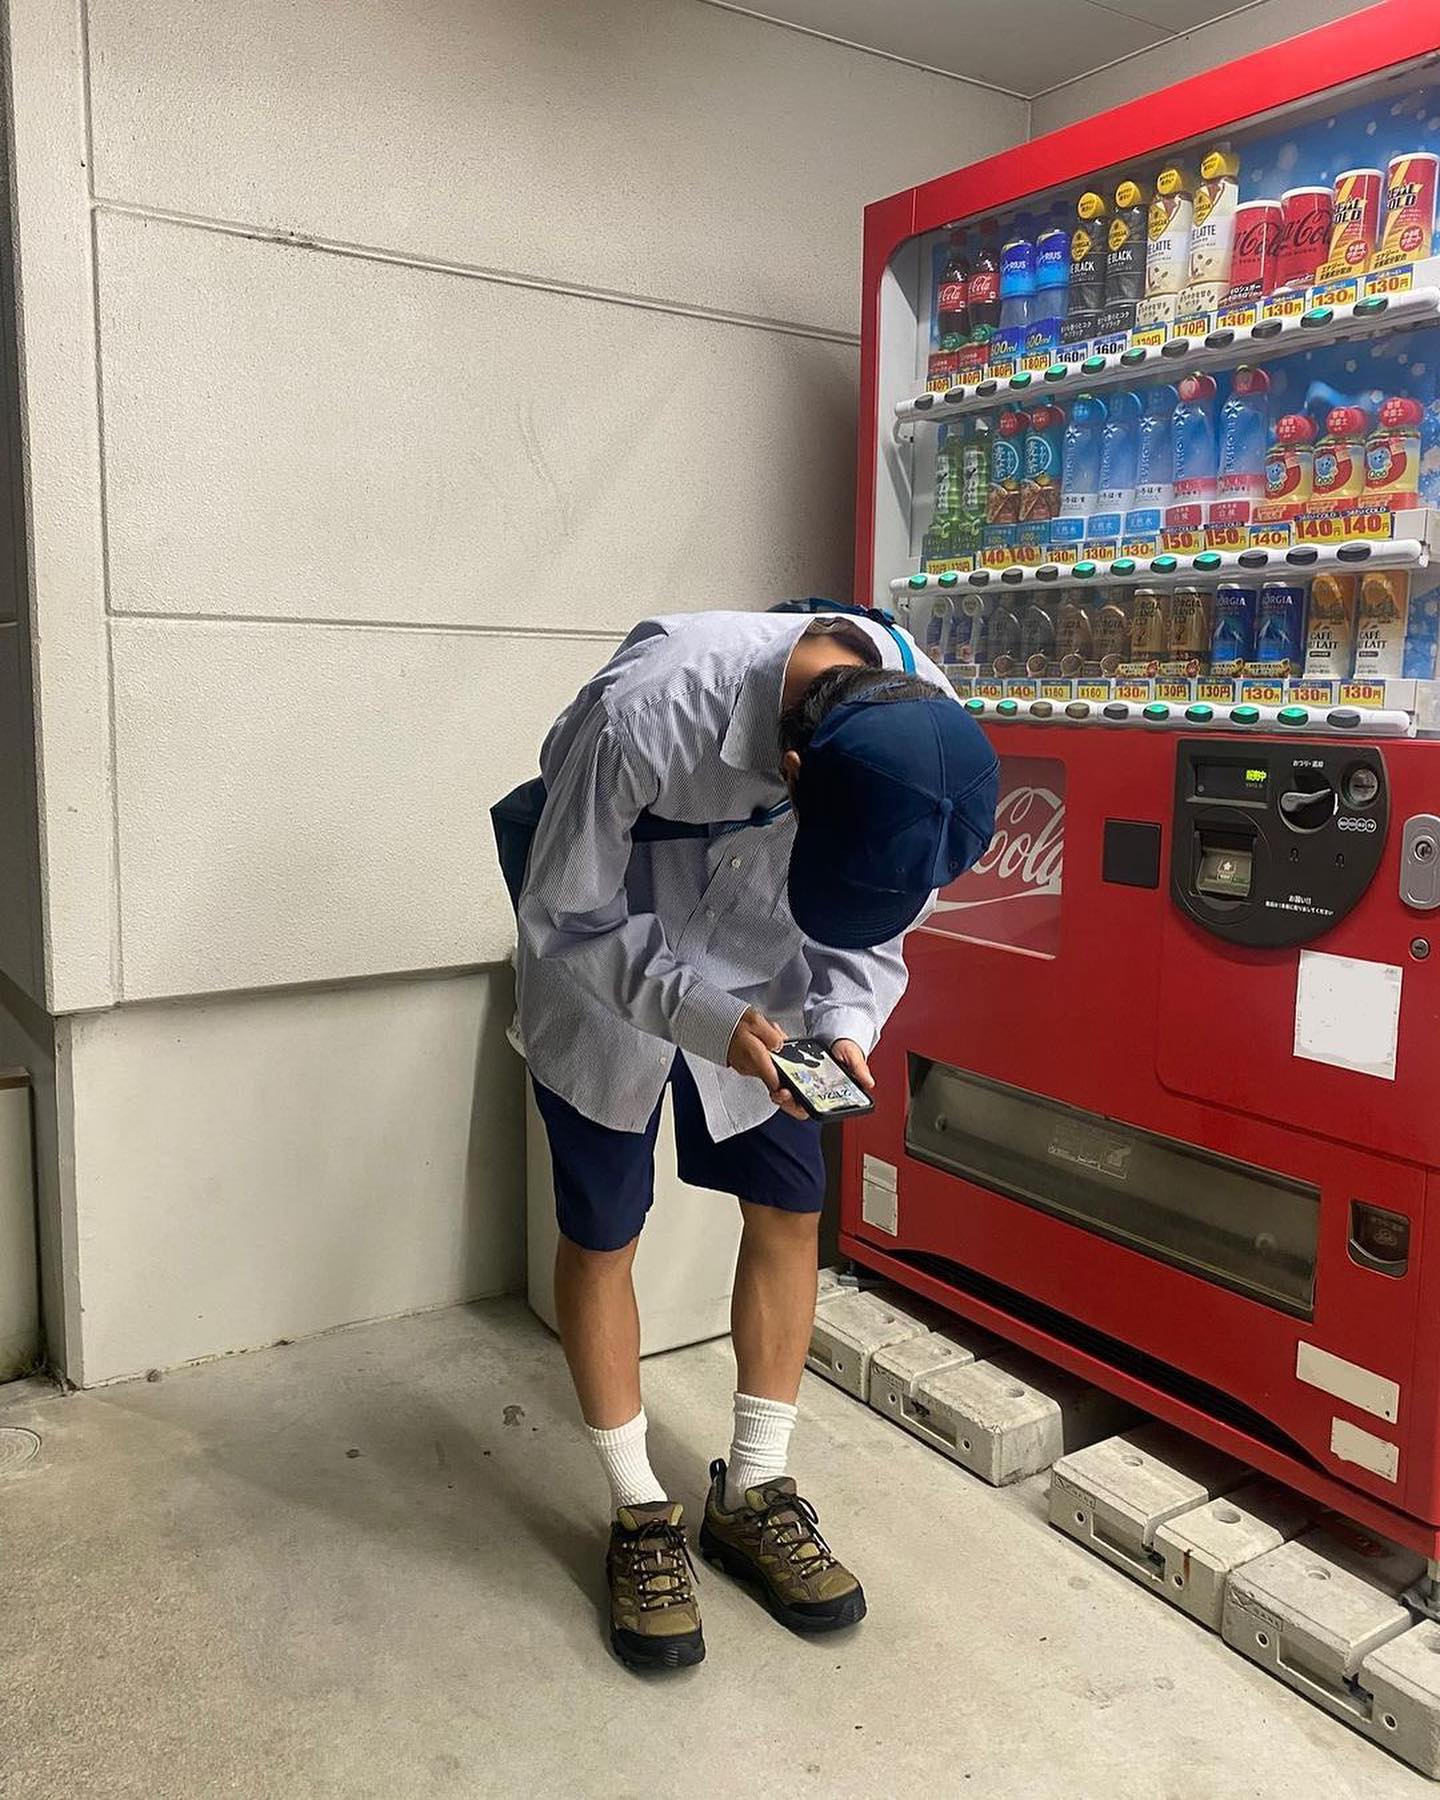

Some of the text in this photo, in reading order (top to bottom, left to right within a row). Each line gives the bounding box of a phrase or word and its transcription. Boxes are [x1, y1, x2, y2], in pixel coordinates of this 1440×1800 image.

[1369, 277, 1409, 294] 130円
[1315, 289, 1354, 306] 130円
[1266, 301, 1301, 317] 130円
[1295, 520, 1341, 539] 140円
[1344, 514, 1389, 535] 140円
[1162, 532, 1199, 550] 150円
[1205, 528, 1247, 546] 150円
[1253, 532, 1287, 546] 140円
[1160, 685, 1186, 697] 130円
[1200, 685, 1231, 698] 130円
[1293, 688, 1328, 701] 130円
[1343, 685, 1382, 699] 130円
